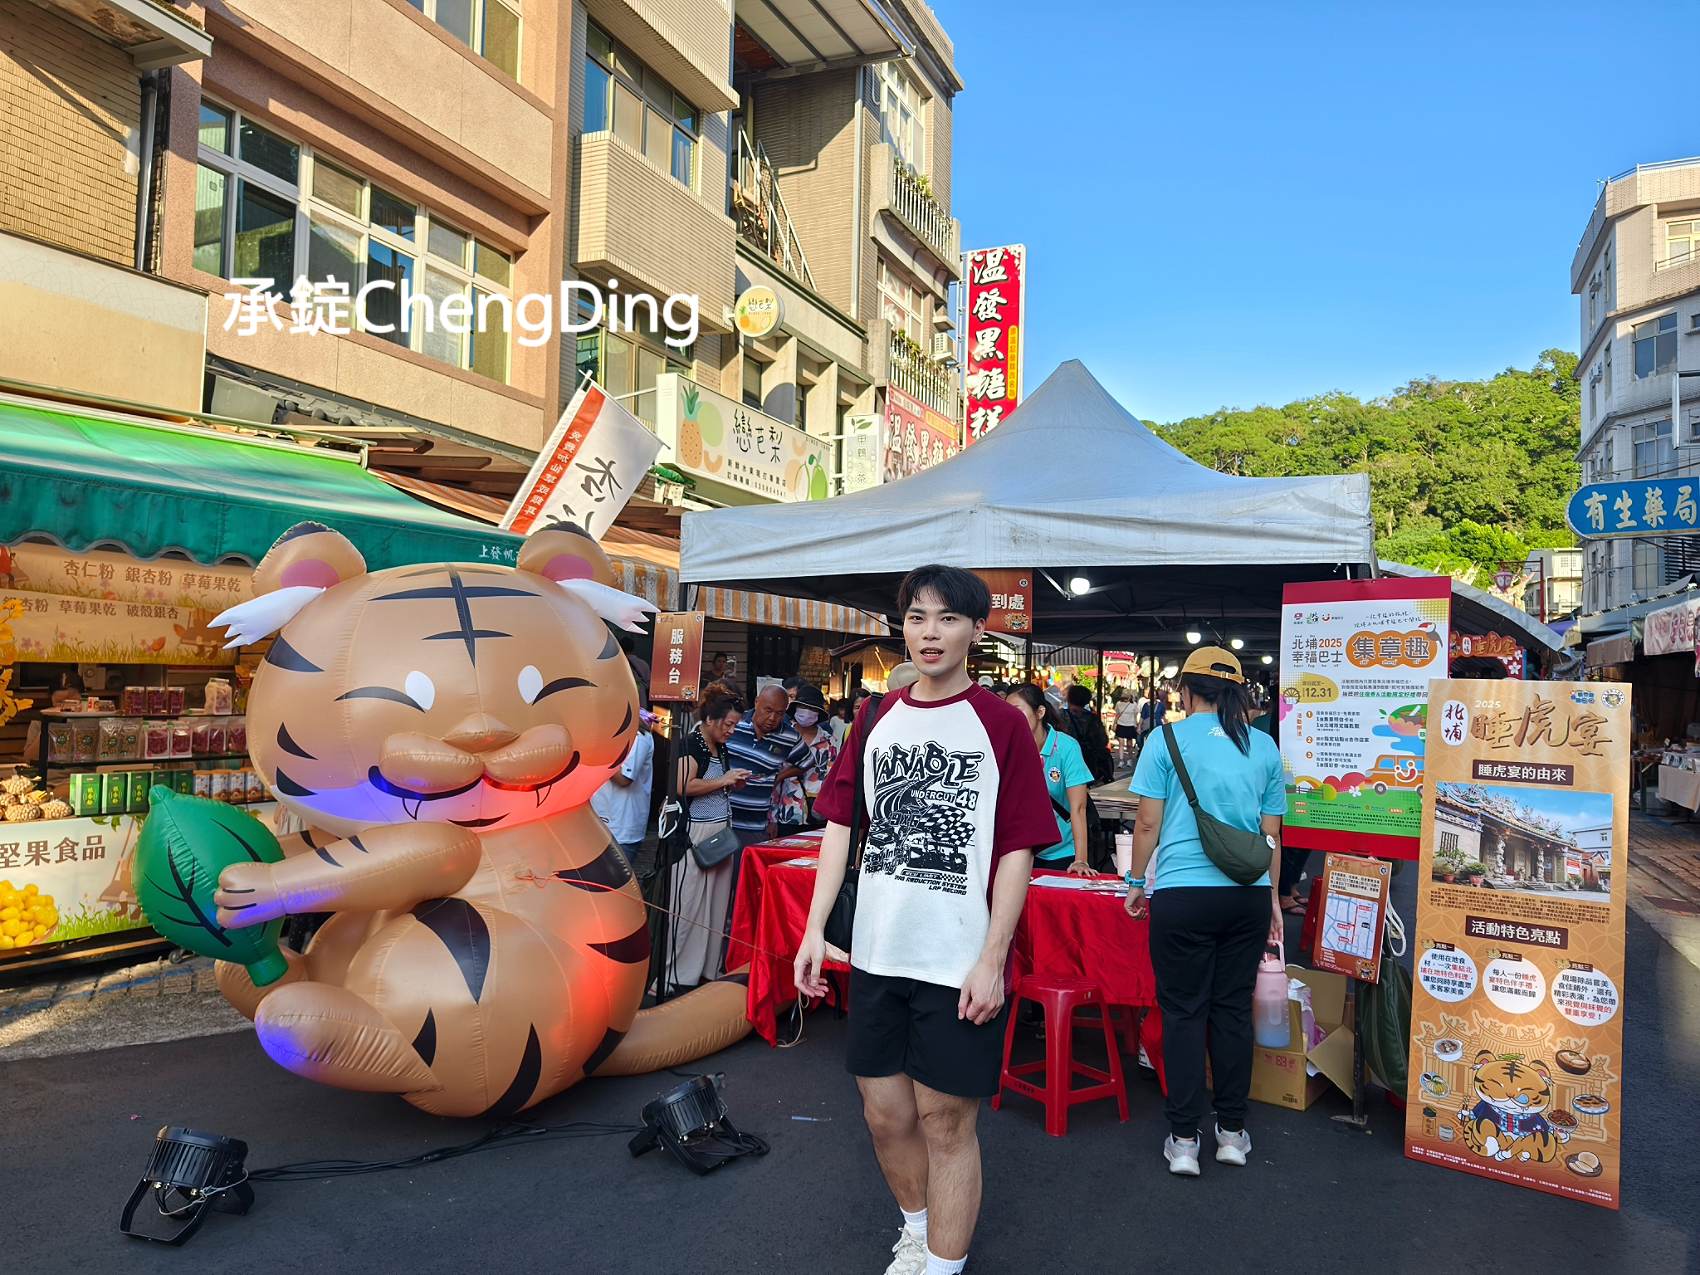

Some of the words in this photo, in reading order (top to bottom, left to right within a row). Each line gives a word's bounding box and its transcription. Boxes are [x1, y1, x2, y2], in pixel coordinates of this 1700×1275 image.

[1583, 484, 1697, 531] 有生藥局
[64, 560, 115, 581] 杏仁粉
[125, 566, 173, 586] 銀杏粉
[182, 572, 241, 593] 草莓果乾
[58, 600, 117, 617] 草莓果乾
[668, 628, 683, 684] 服務台
[1291, 650, 1343, 664] 幸福巴士
[1352, 636, 1429, 660] 集章趣
[1306, 687, 1332, 698] 12.31
[1444, 703, 1465, 742] 北埔
[873, 741, 985, 789] VARIABLE
[1478, 763, 1566, 781] 睡虎宴的由來
[911, 789, 956, 803] UNDERCUT
[955, 788, 979, 811] 48
[0, 834, 106, 868] 堅果食品
[1471, 919, 1561, 945] 活動特色亮點
